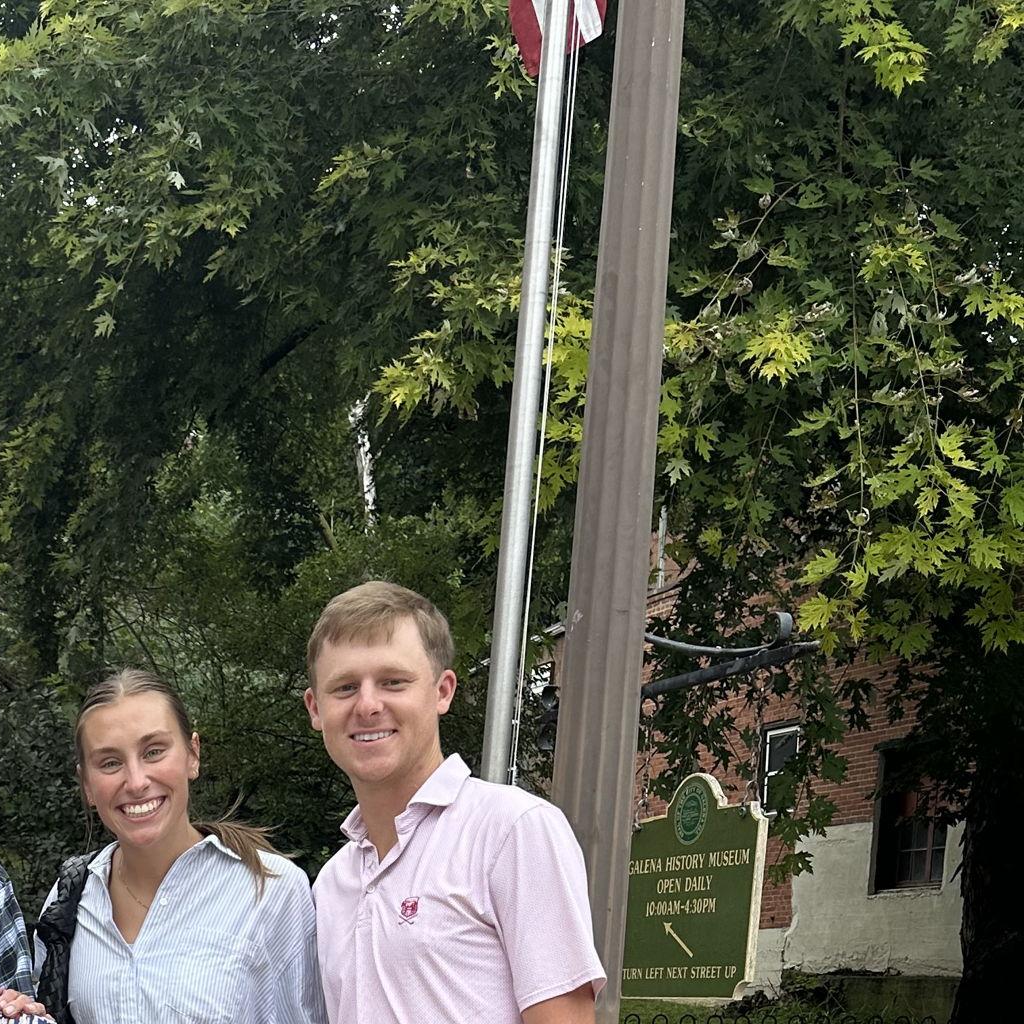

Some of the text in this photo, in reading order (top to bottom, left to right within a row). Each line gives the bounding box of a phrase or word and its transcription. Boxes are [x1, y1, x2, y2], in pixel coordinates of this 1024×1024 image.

[628, 848, 751, 876] GALENA HISTORY MUSEUM
[656, 875, 713, 894] OPEN DAILY
[645, 897, 717, 917] 10:00AM-4:30PM
[622, 965, 737, 980] TURN LEFT NEXT STREET UP
